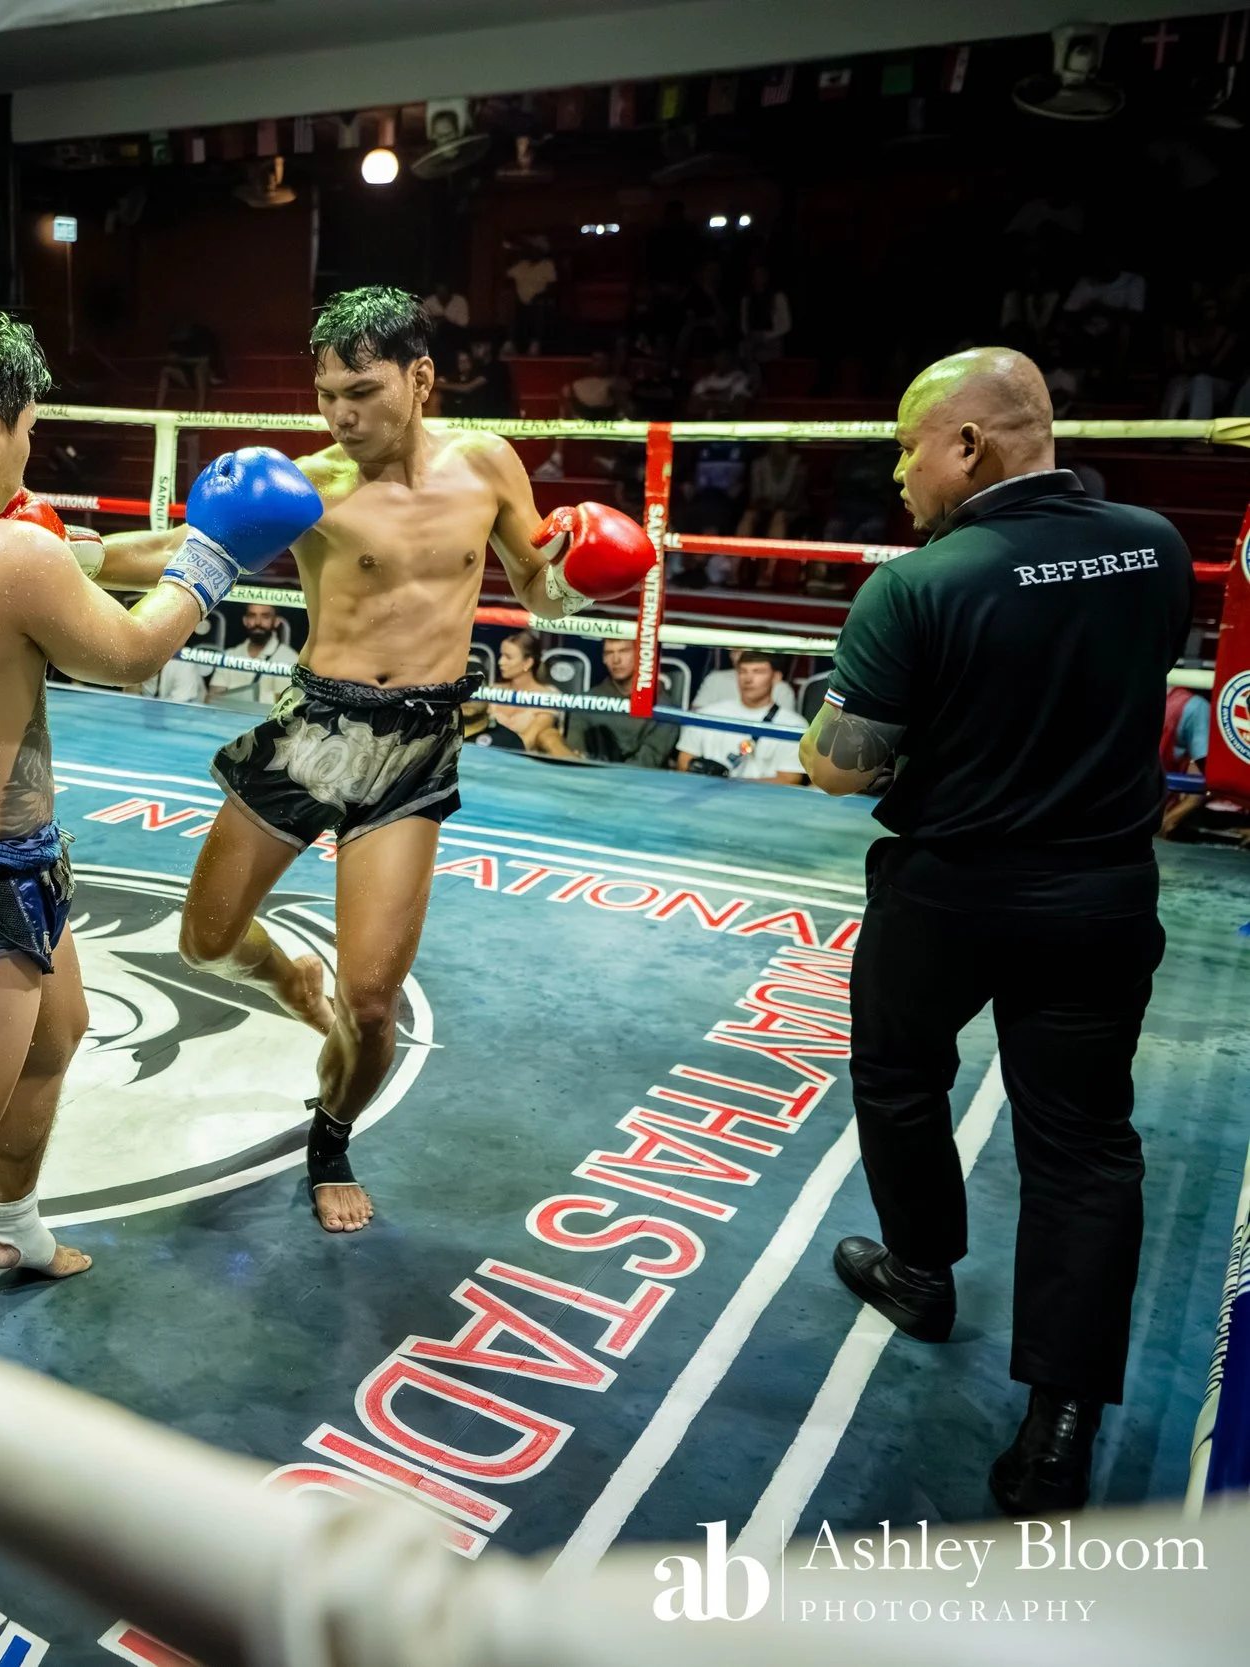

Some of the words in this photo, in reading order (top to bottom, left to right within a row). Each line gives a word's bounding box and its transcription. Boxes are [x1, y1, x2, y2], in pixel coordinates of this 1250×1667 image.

[1013, 548, 1159, 587] REFEREE
[180, 646, 223, 664] SAMUI
[224, 657, 292, 676] INTERNATI
[471, 686, 517, 704] AMUI
[517, 691, 631, 713] INTERNATIONA
